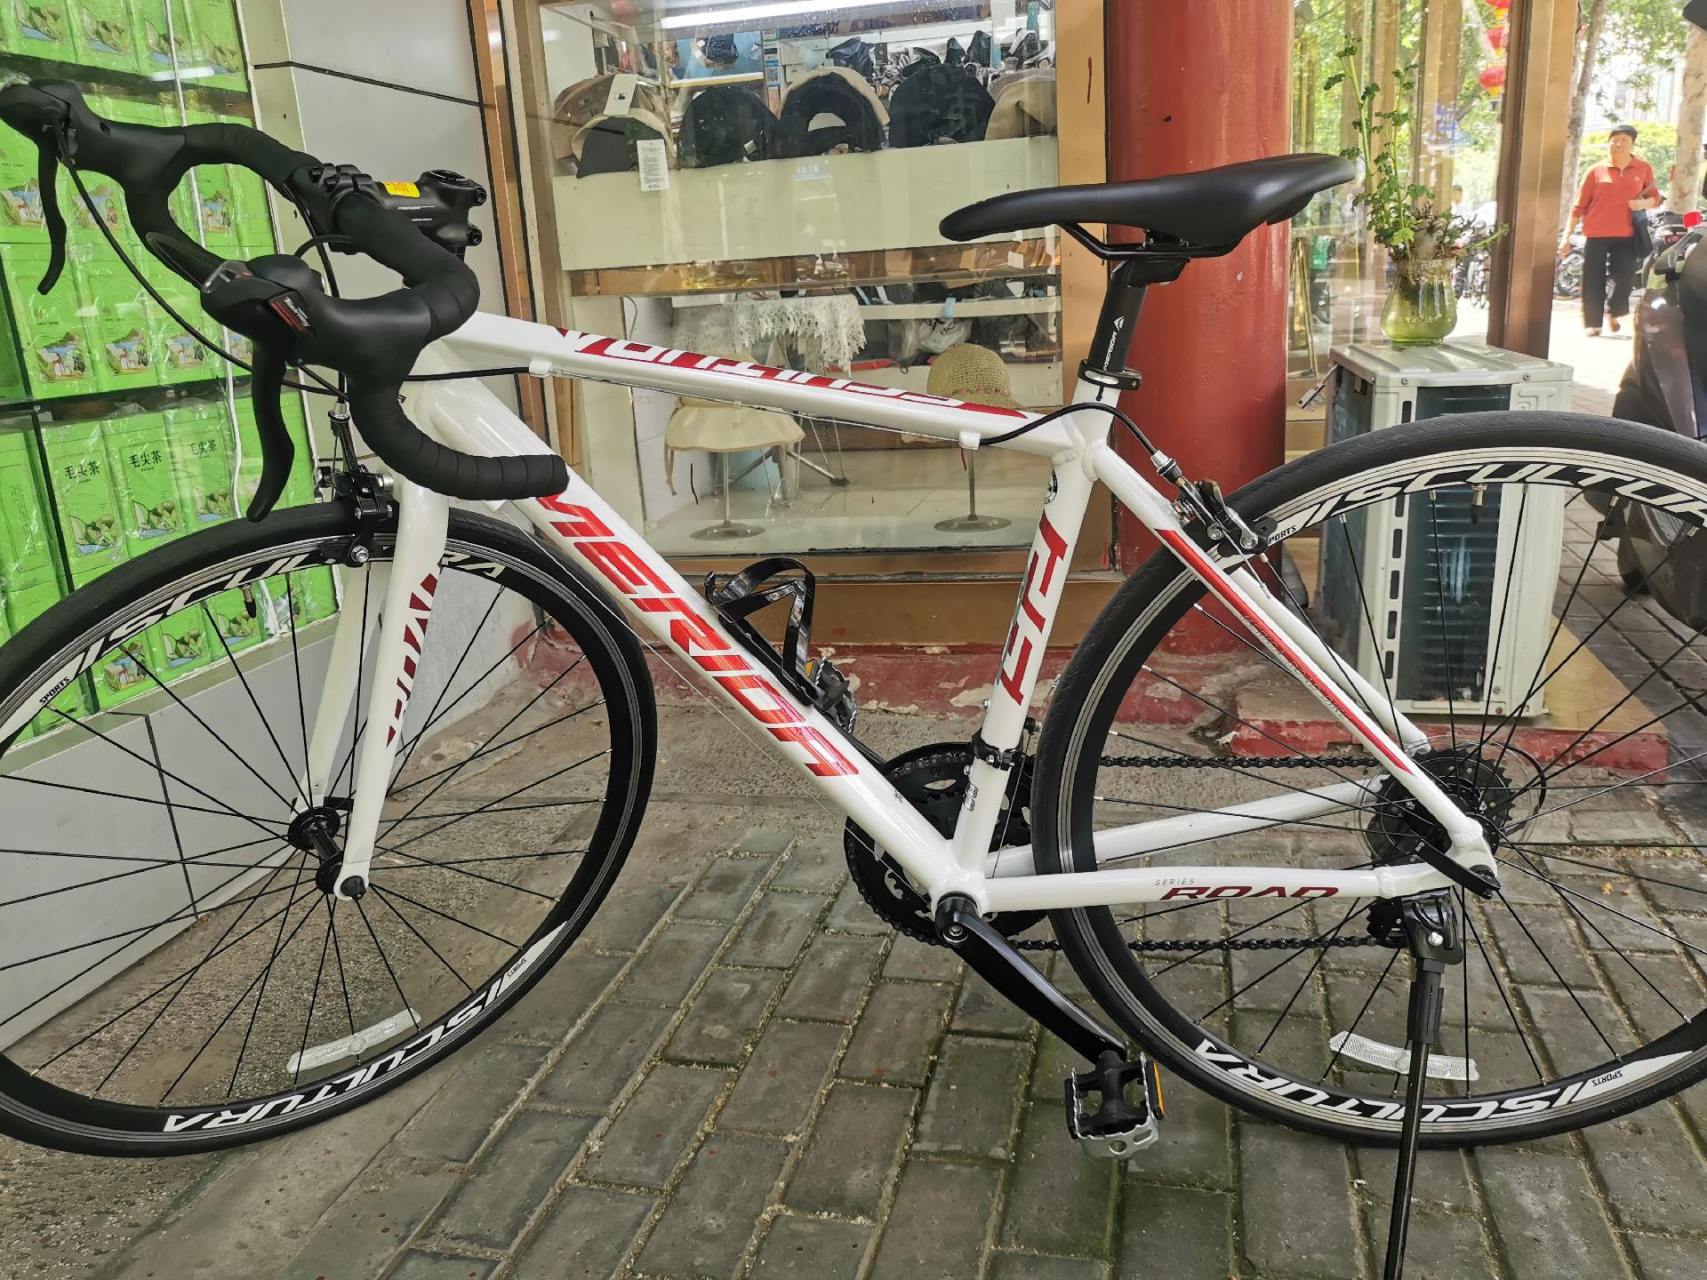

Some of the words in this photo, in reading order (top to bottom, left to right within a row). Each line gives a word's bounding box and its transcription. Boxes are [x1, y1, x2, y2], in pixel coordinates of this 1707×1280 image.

[189, 439, 217, 456] 毛尖茶
[128, 450, 163, 468] 毛尖茶
[64, 461, 100, 480] 毛尖茶
[1268, 524, 1297, 545] PORTS
[39, 676, 71, 705] SPORTS
[1154, 877, 1196, 887] SERIES
[1159, 885, 1340, 901] ROAD
[1592, 1069, 1624, 1088] SPORTS
